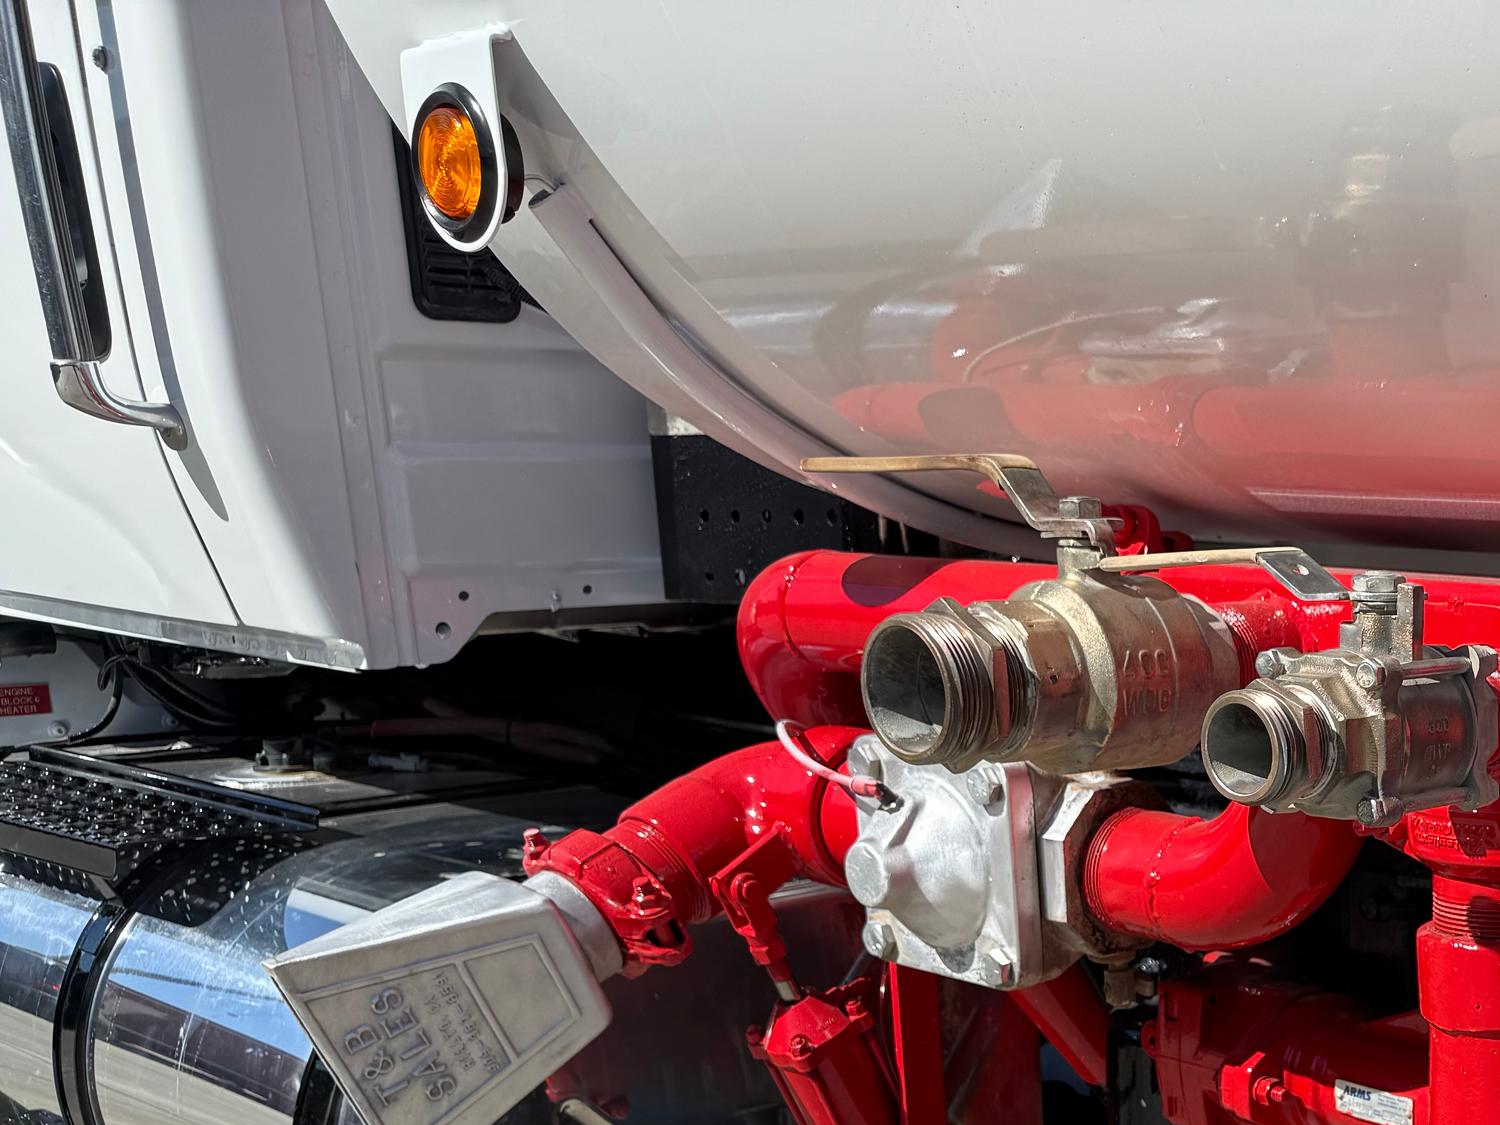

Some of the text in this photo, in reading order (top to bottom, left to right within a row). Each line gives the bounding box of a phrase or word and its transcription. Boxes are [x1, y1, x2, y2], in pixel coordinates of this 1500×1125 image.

[1, 696, 33, 705] BLOCK
[0, 705, 37, 715] HEATER
[370, 987, 456, 1101] SALES
[344, 1023, 410, 1106] T&B
[1343, 1085, 1371, 1102] ARMS
